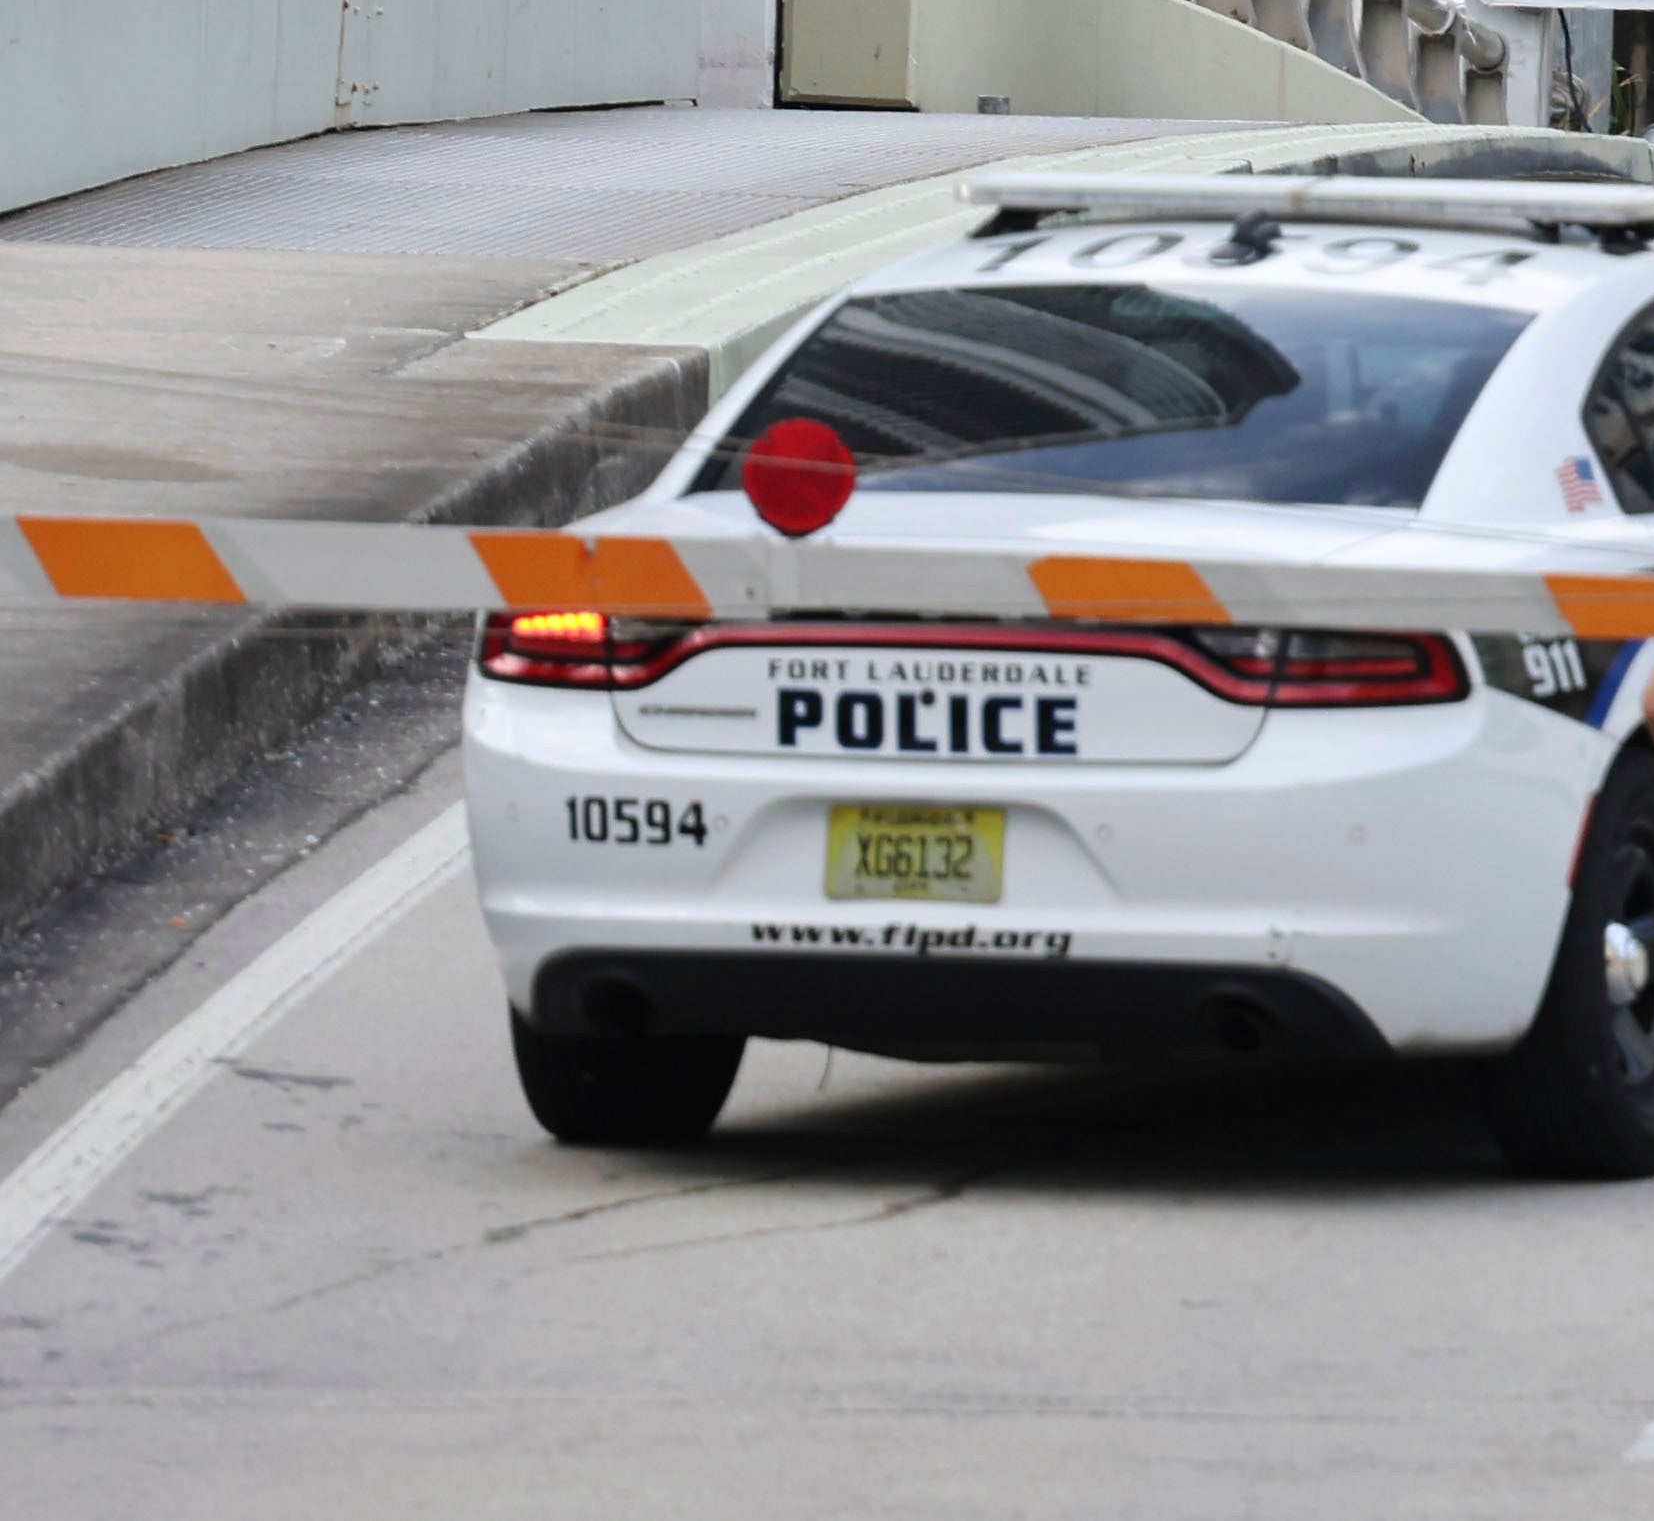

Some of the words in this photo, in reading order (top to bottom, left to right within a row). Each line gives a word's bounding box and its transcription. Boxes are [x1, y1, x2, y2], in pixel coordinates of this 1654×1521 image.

[768, 659, 849, 680] FORT
[867, 661, 1091, 686] LAUDERDALE
[1523, 639, 1586, 697] 911
[777, 686, 1079, 755] POLICE
[567, 796, 708, 847] 10594
[855, 832, 973, 879] XG6132
[752, 923, 1072, 959] www.flpd.org
